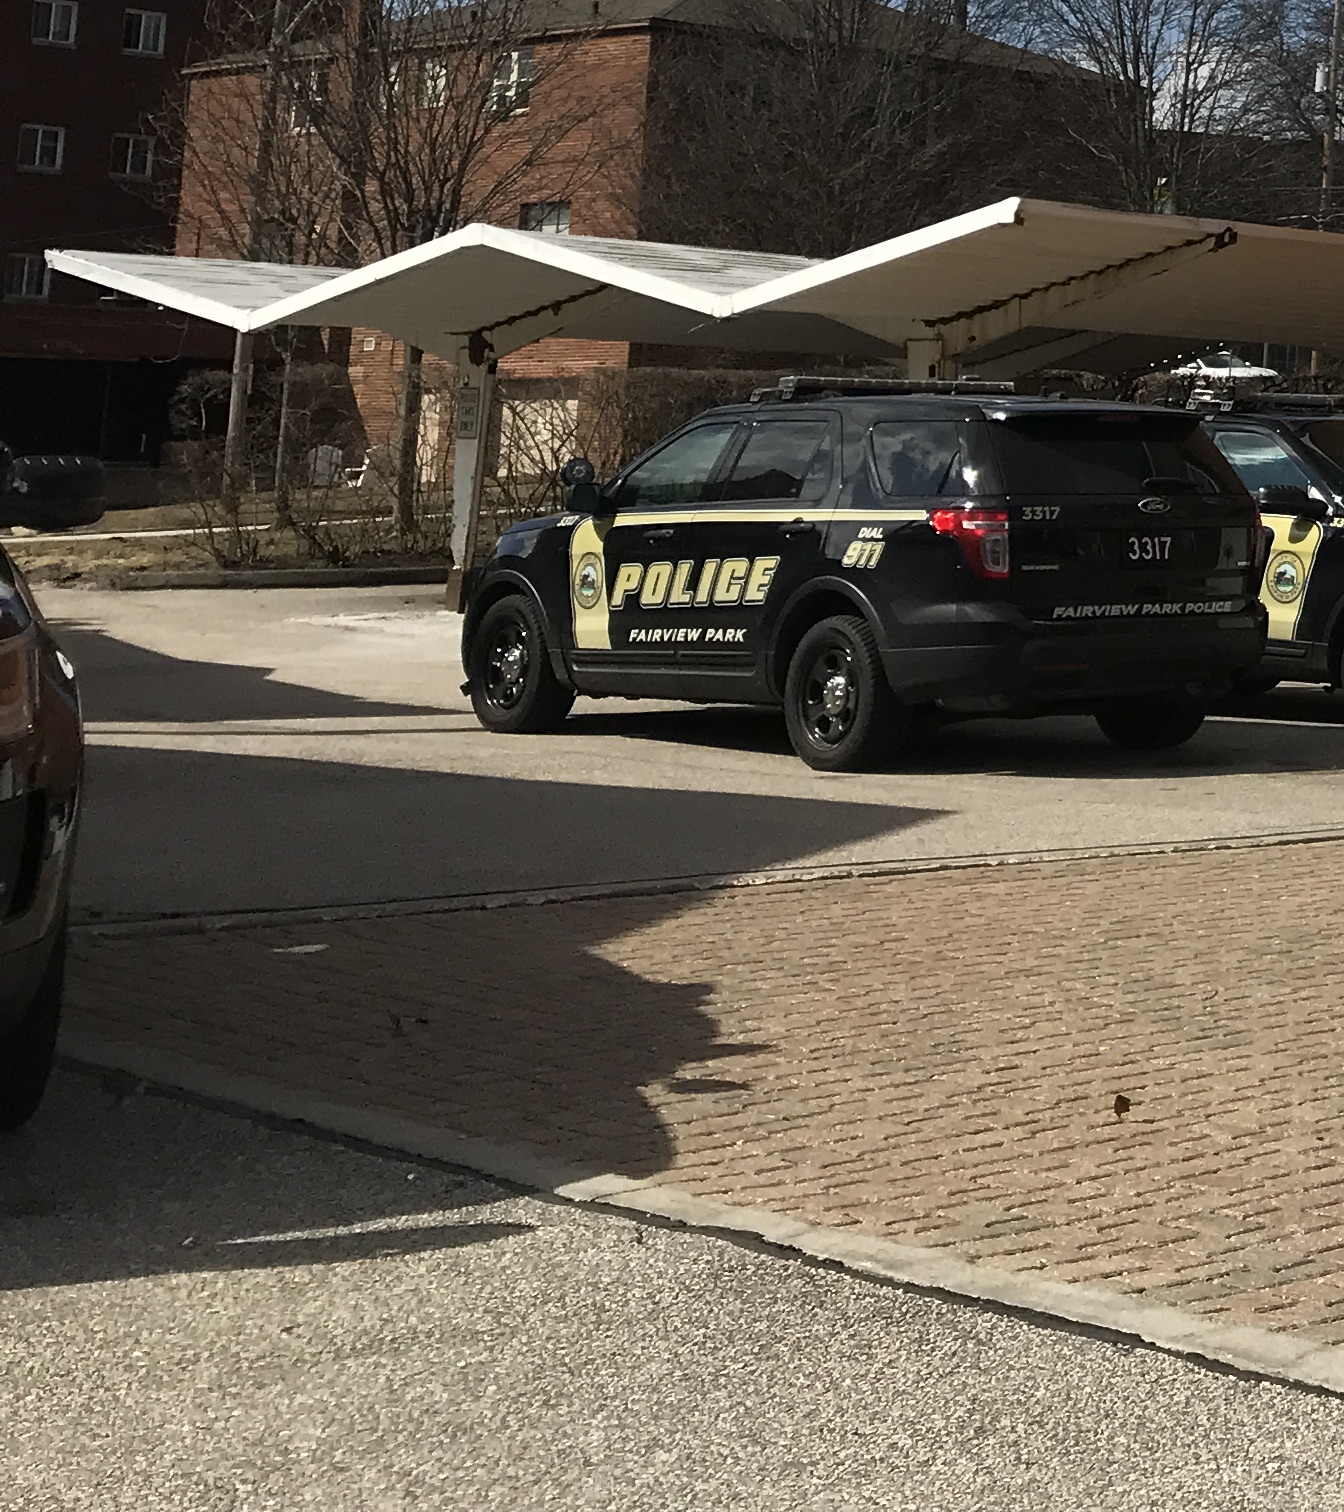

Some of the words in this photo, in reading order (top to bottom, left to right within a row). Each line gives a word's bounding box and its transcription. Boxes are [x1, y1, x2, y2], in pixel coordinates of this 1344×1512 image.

[1022, 506, 1060, 520] 3317
[858, 527, 883, 538] DIAL
[841, 540, 886, 569] 911
[1128, 536, 1171, 560] 3317
[609, 556, 781, 610] POLICE
[1052, 603, 1140, 619] FAIRVIEW
[1141, 602, 1183, 615] PARK
[1185, 601, 1232, 614] POLICE
[629, 628, 703, 643] FAIRVIEW
[704, 628, 747, 642] PARK
